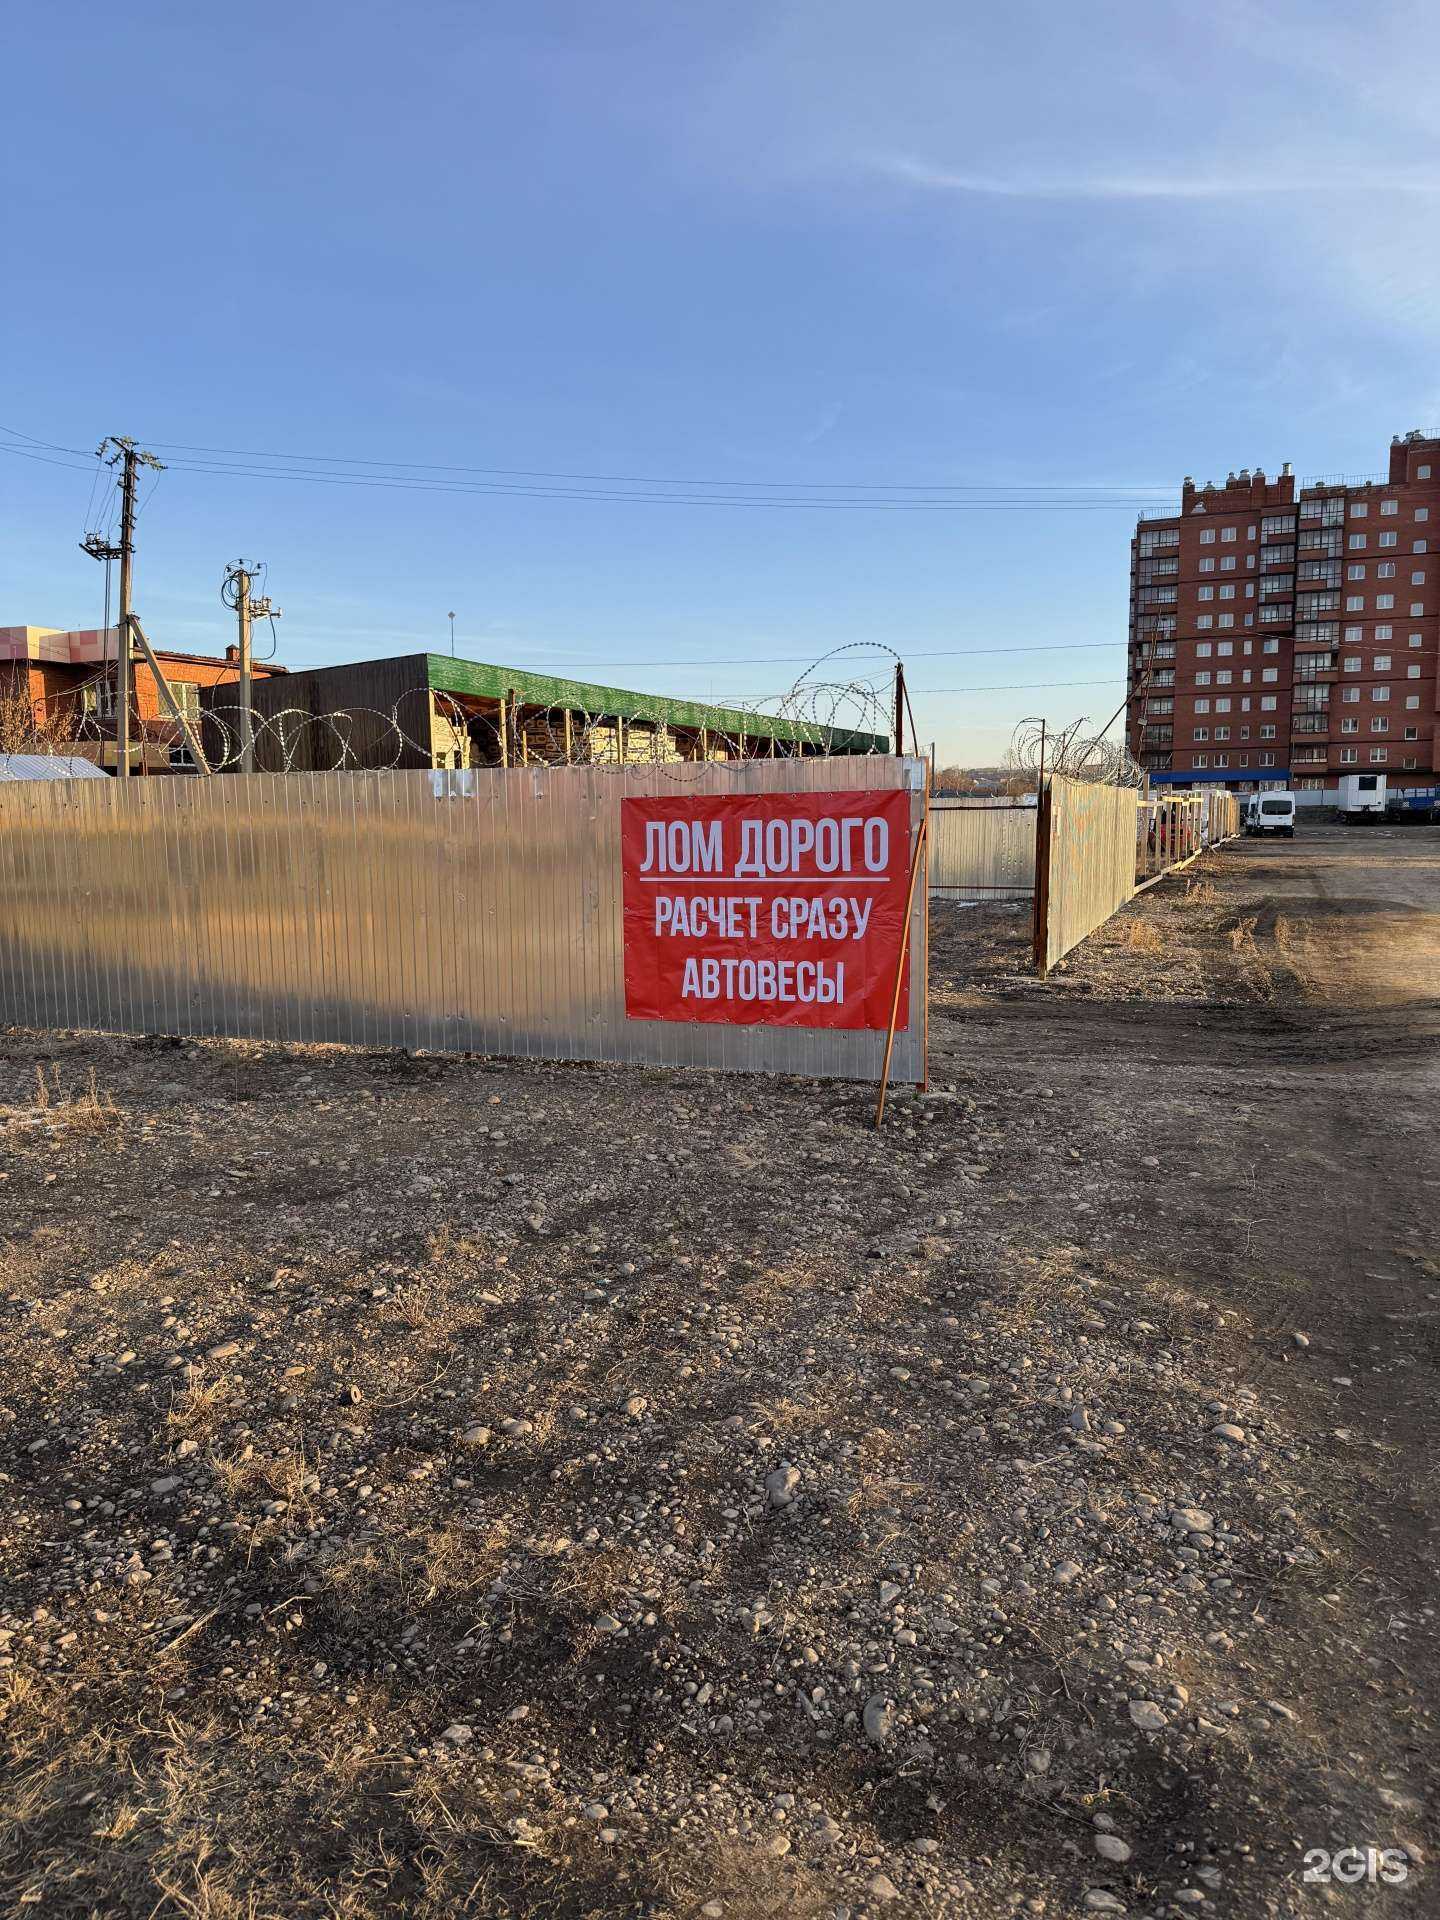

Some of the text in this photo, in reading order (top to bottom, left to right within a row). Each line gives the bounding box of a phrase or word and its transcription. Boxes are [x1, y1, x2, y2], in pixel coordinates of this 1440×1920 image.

[639, 817, 889, 878] ЛОМ ДОРОГО
[655, 896, 873, 940] РАСЧЕТ СРАЗУ
[681, 957, 844, 1004] АВТОВЕСЫ
